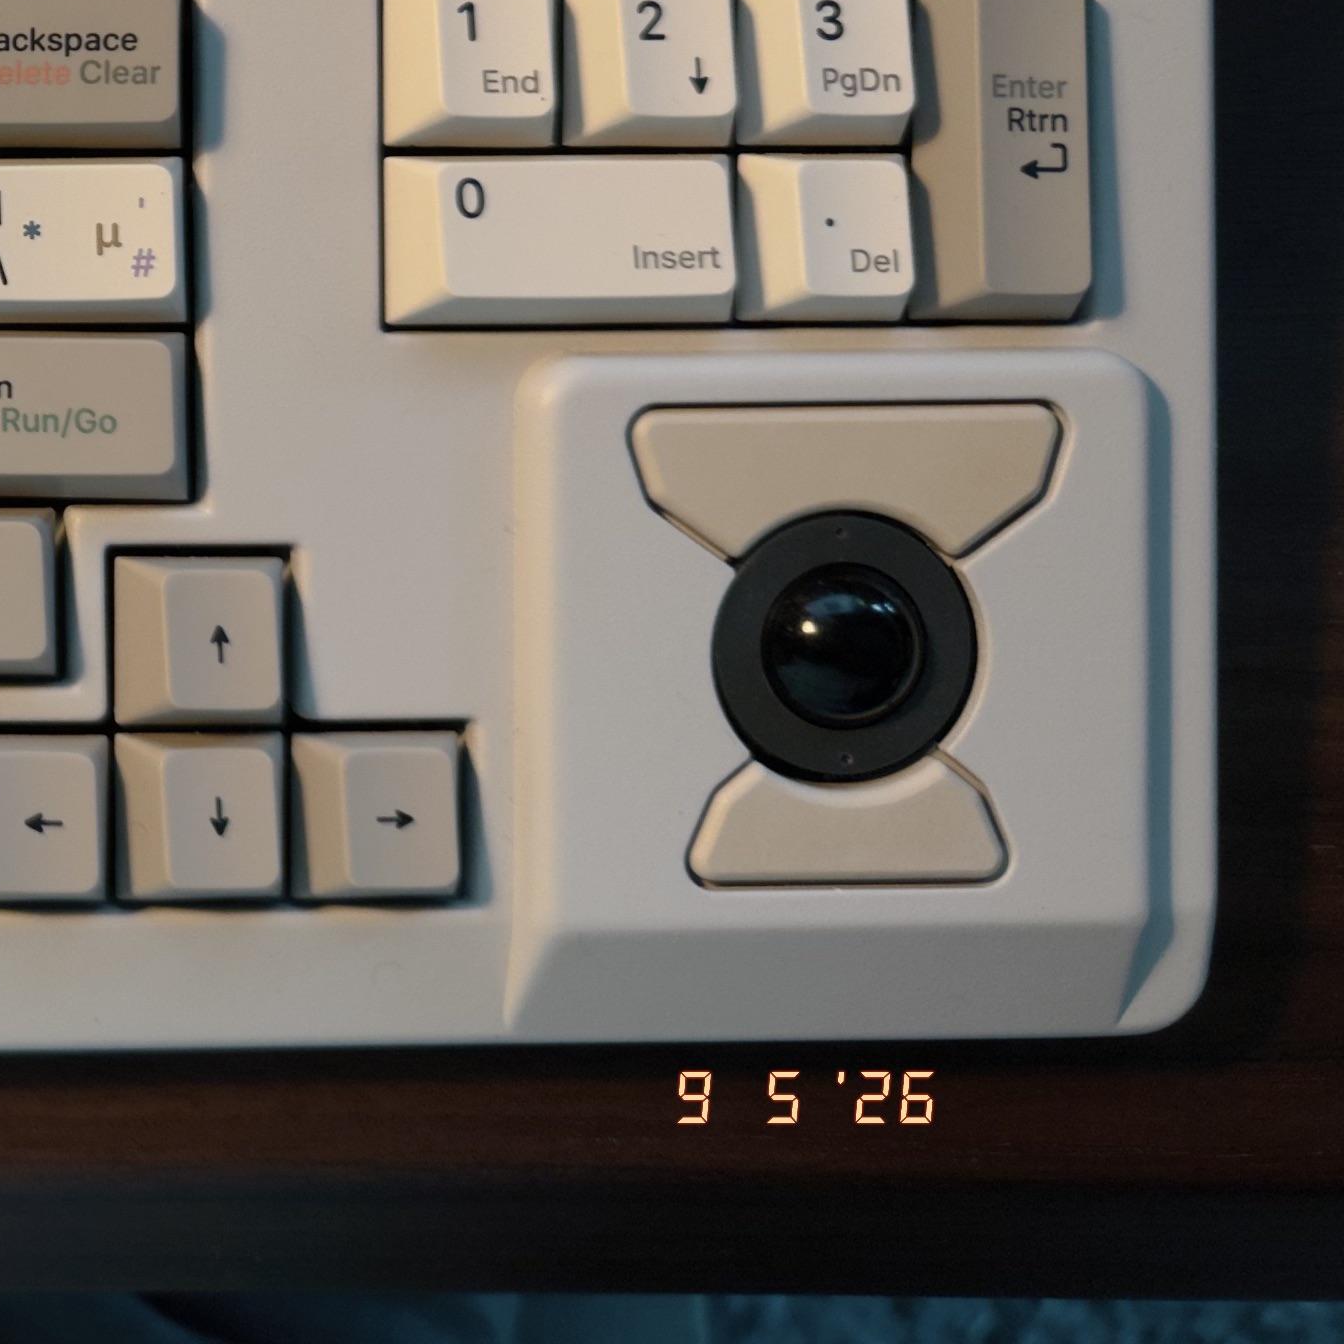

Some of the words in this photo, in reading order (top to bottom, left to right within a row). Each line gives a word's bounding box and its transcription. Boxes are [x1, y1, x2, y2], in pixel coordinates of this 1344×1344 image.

[637, 0, 666, 41] 2
[816, 0, 844, 41] 3
[79, 59, 161, 85] Clear
[482, 69, 540, 94] End
[822, 67, 902, 98] PgDn
[992, 73, 1068, 99] Enter
[1008, 107, 1068, 132] Rtrn
[131, 248, 156, 277] #
[633, 245, 722, 269] Insert
[850, 249, 899, 273] Del
[1, 407, 118, 438] Run/Go
